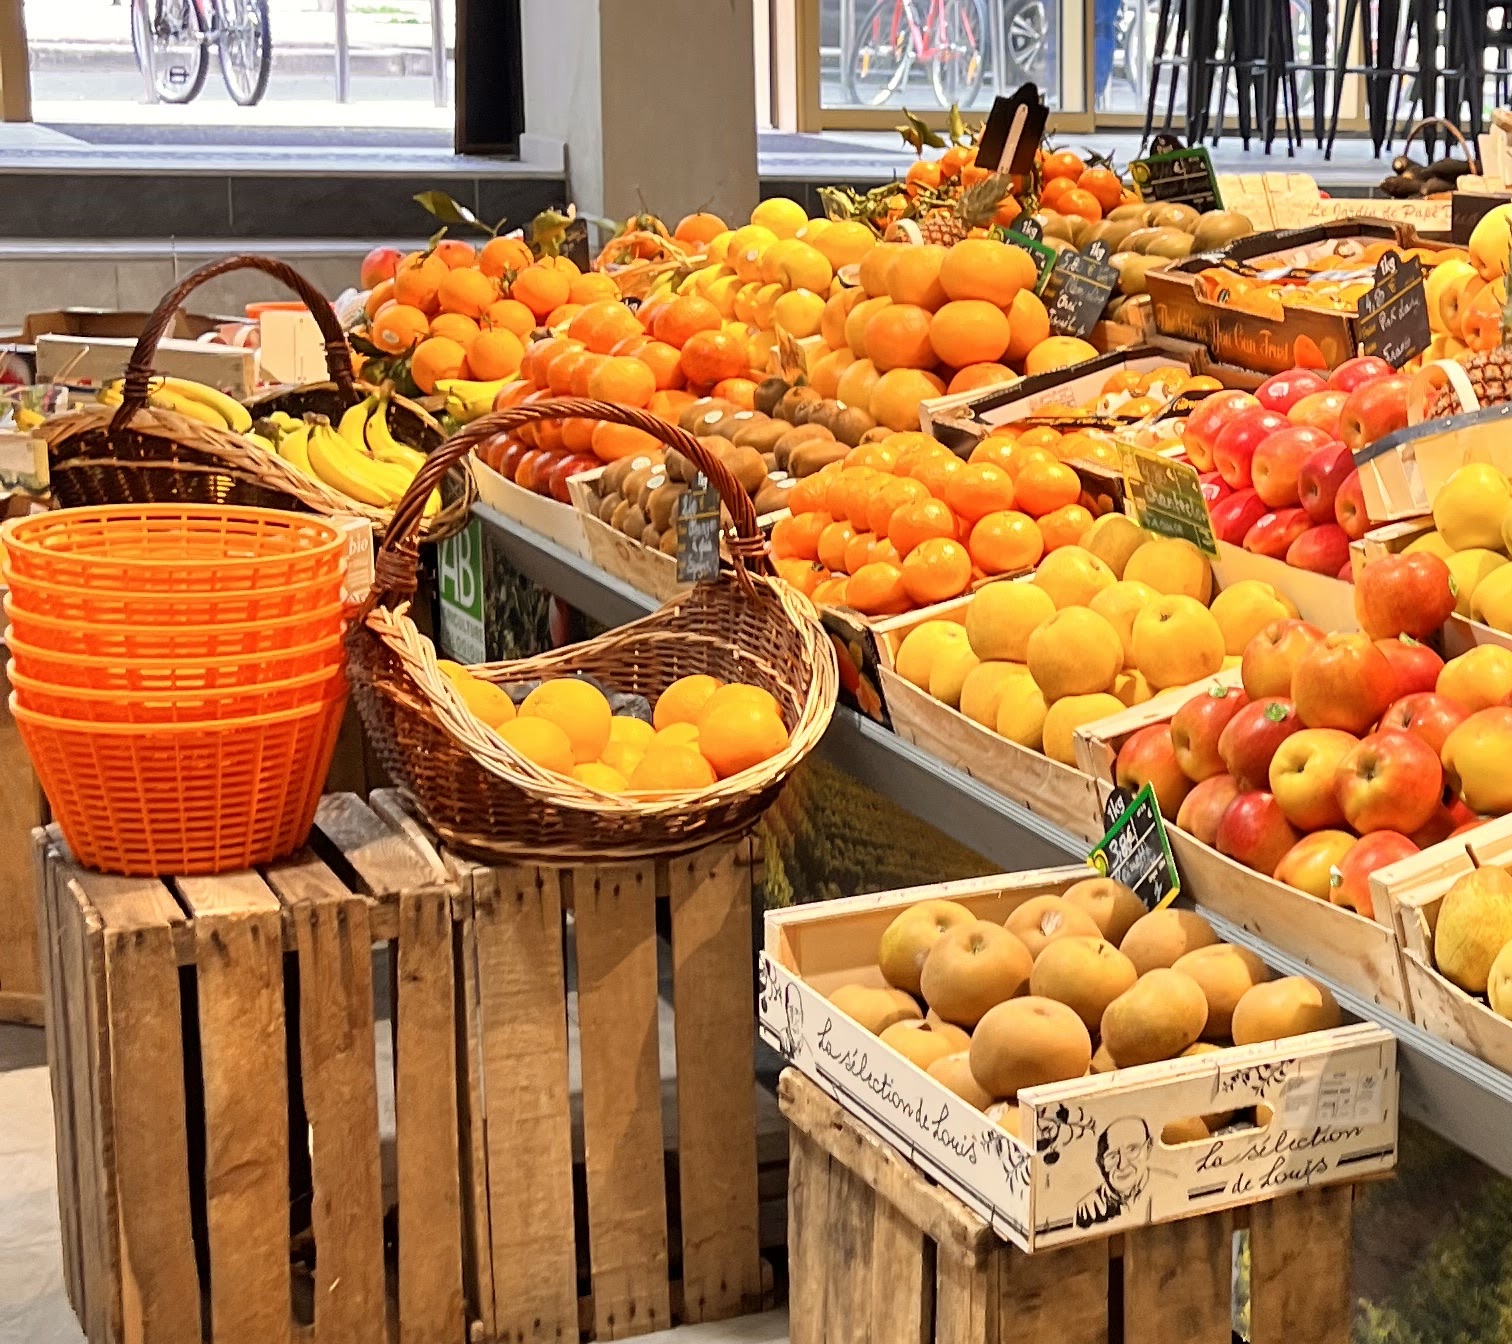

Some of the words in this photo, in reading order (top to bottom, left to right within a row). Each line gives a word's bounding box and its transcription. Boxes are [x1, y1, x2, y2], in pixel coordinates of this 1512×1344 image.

[440, 526, 476, 609] AB
[1106, 794, 1127, 825] 1kg
[817, 1017, 842, 1059] La
[841, 1047, 915, 1119] sélection
[914, 1098, 931, 1132] de
[931, 1101, 978, 1166] Louis
[1194, 1139, 1240, 1174] La
[1240, 1124, 1364, 1161] sélection
[1231, 1171, 1253, 1195] de
[1258, 1155, 1329, 1187] Louis
